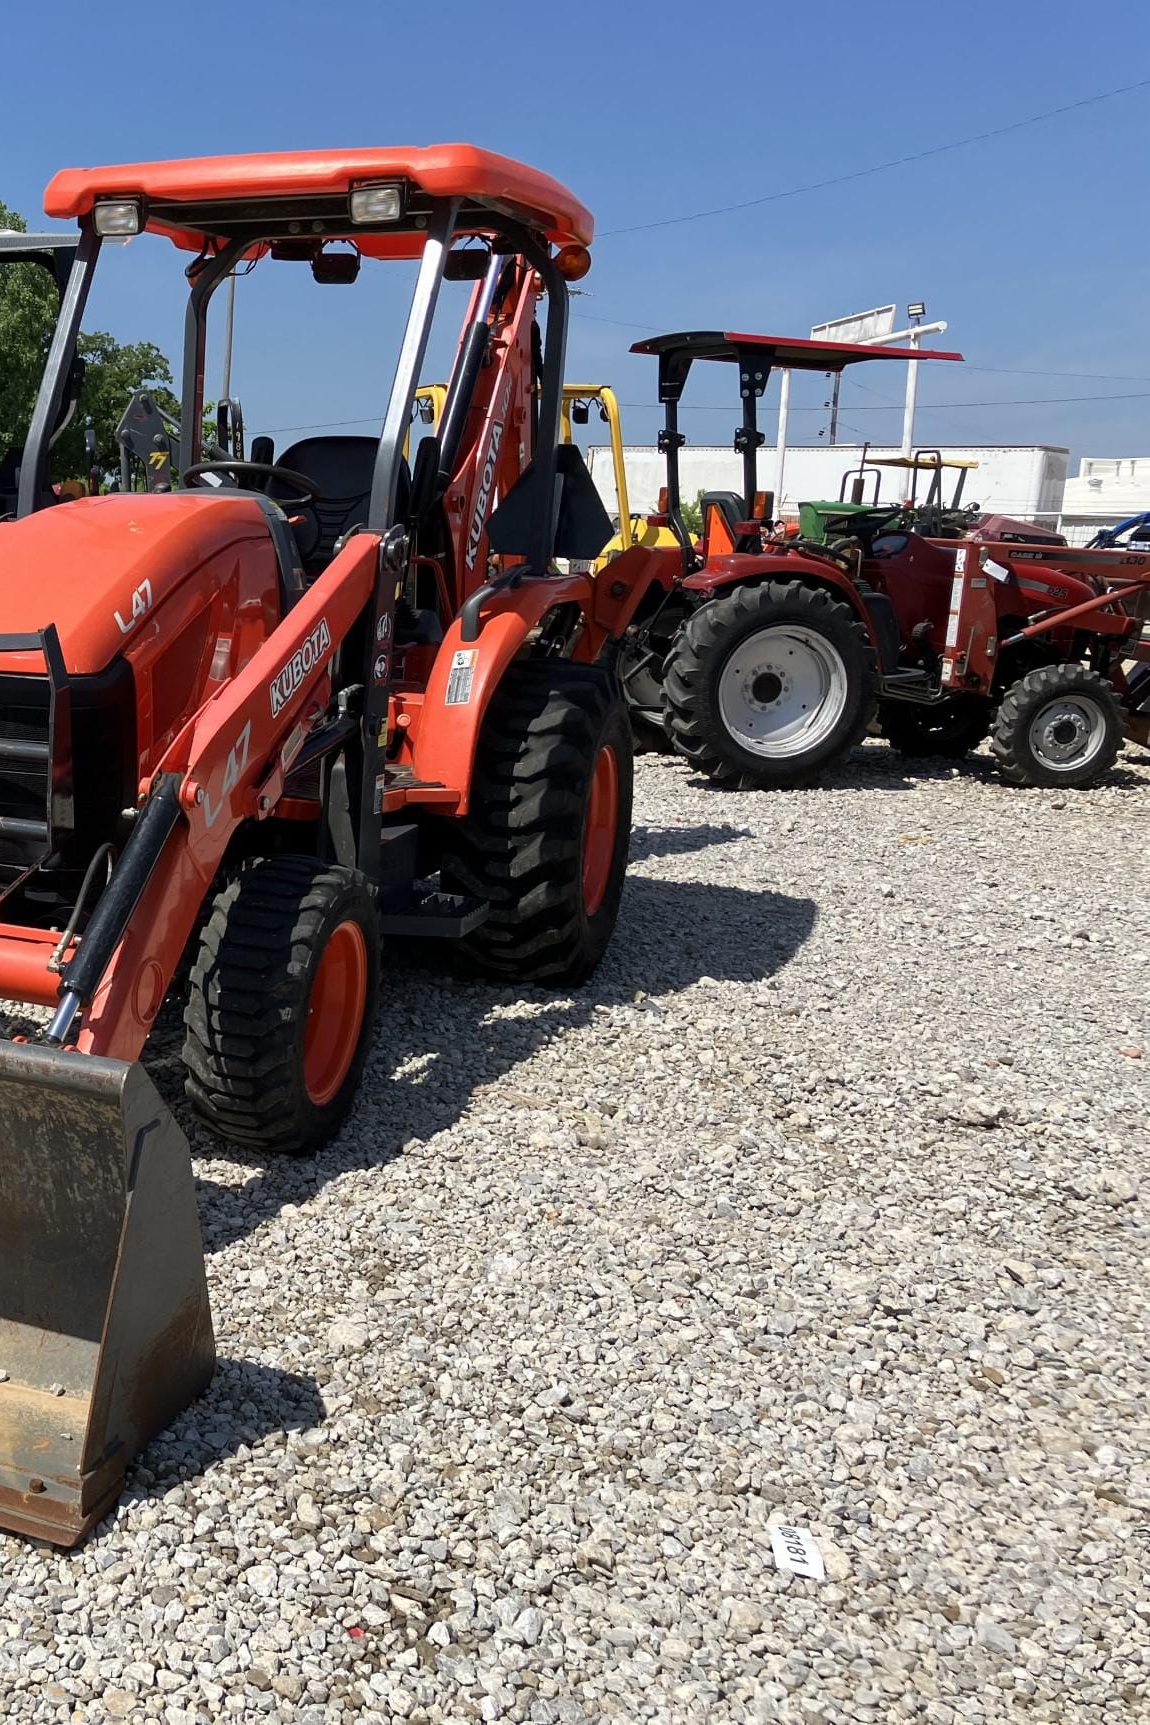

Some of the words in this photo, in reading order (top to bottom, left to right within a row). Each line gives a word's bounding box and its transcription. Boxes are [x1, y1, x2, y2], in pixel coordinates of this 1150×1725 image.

[464, 420, 504, 572] KUBOTA
[113, 577, 153, 634] L47
[1010, 551, 1033, 559] CASE
[270, 616, 331, 720] KUBOTA
[202, 718, 252, 828] L47
